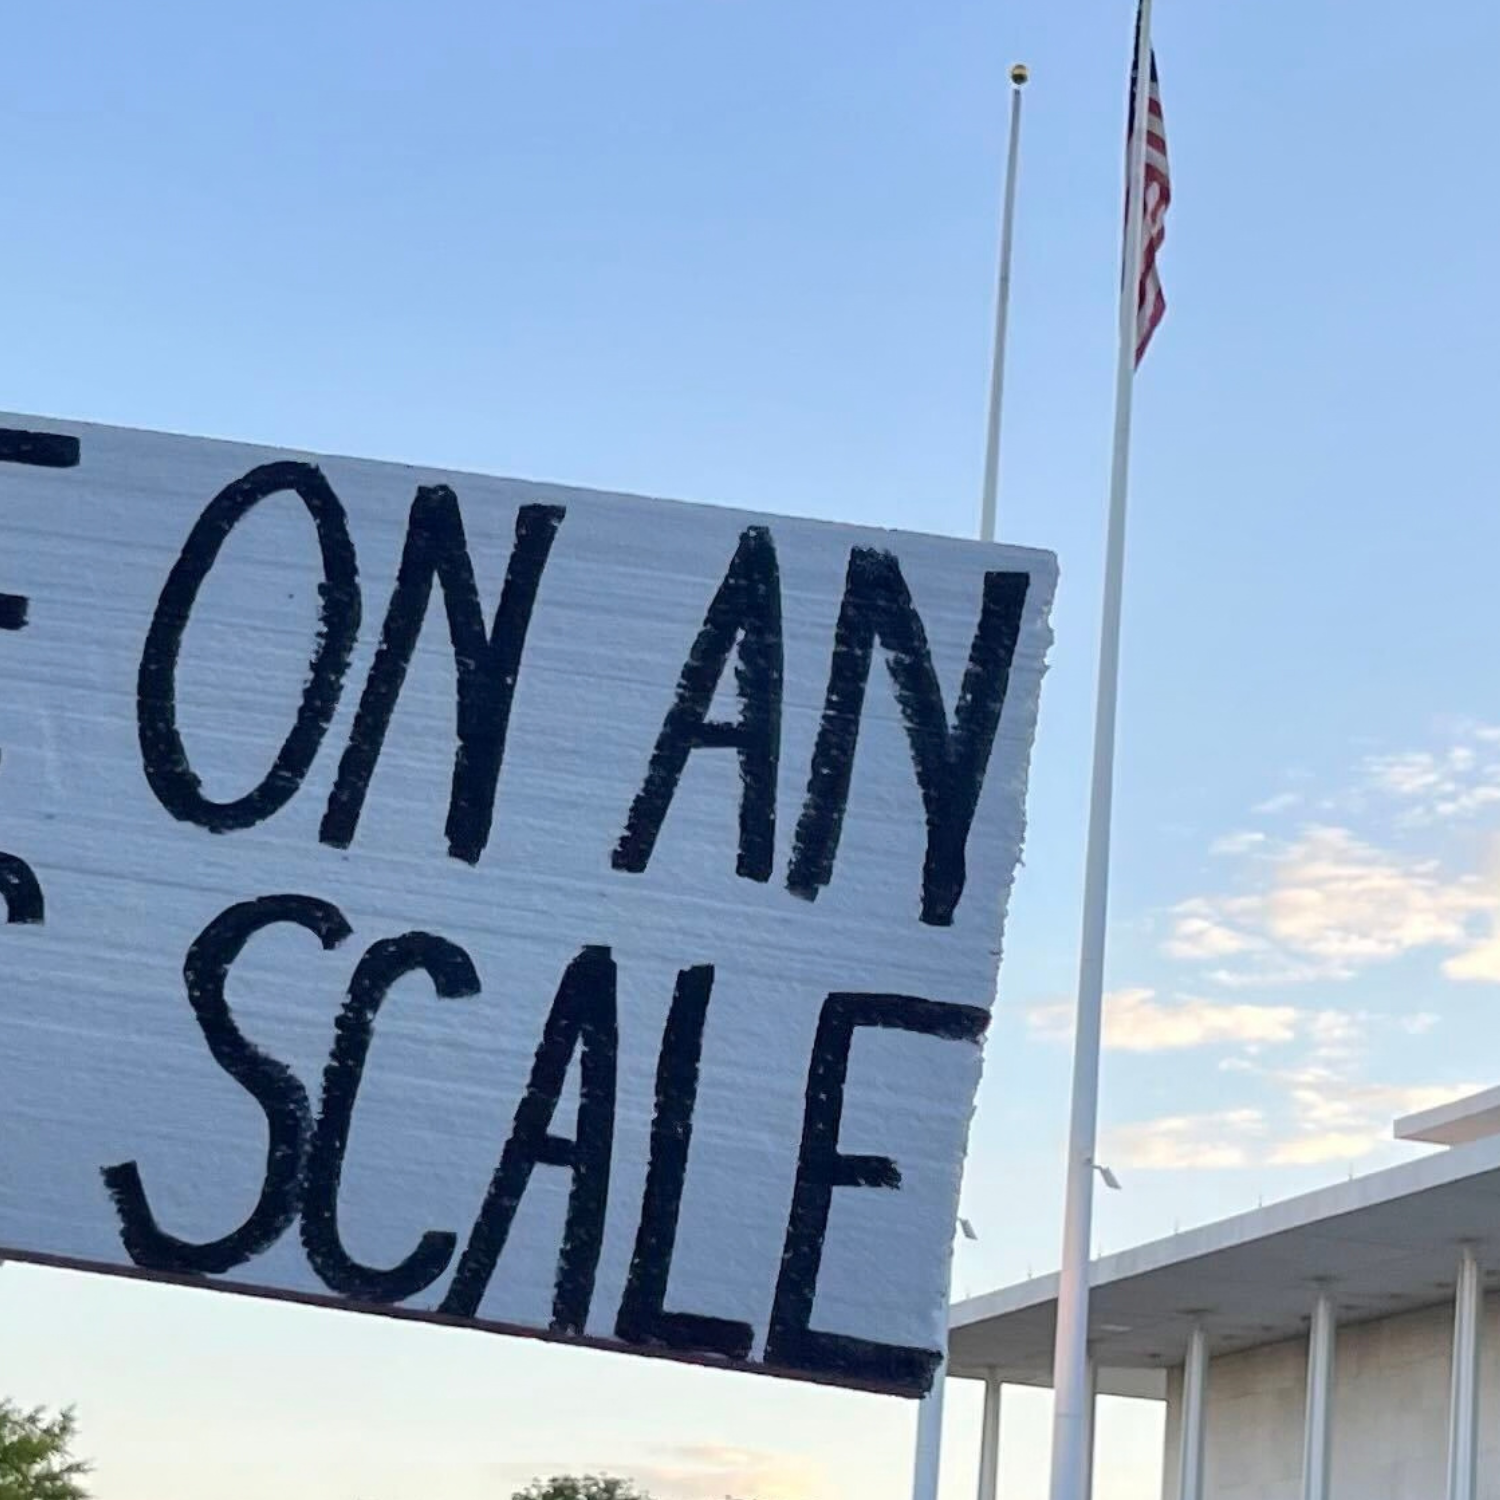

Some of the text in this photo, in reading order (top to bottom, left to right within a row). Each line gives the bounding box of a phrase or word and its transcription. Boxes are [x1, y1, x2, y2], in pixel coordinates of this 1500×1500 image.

[138, 460, 566, 865] ON
[611, 526, 1030, 927] AN
[102, 894, 992, 1398] SCALE
